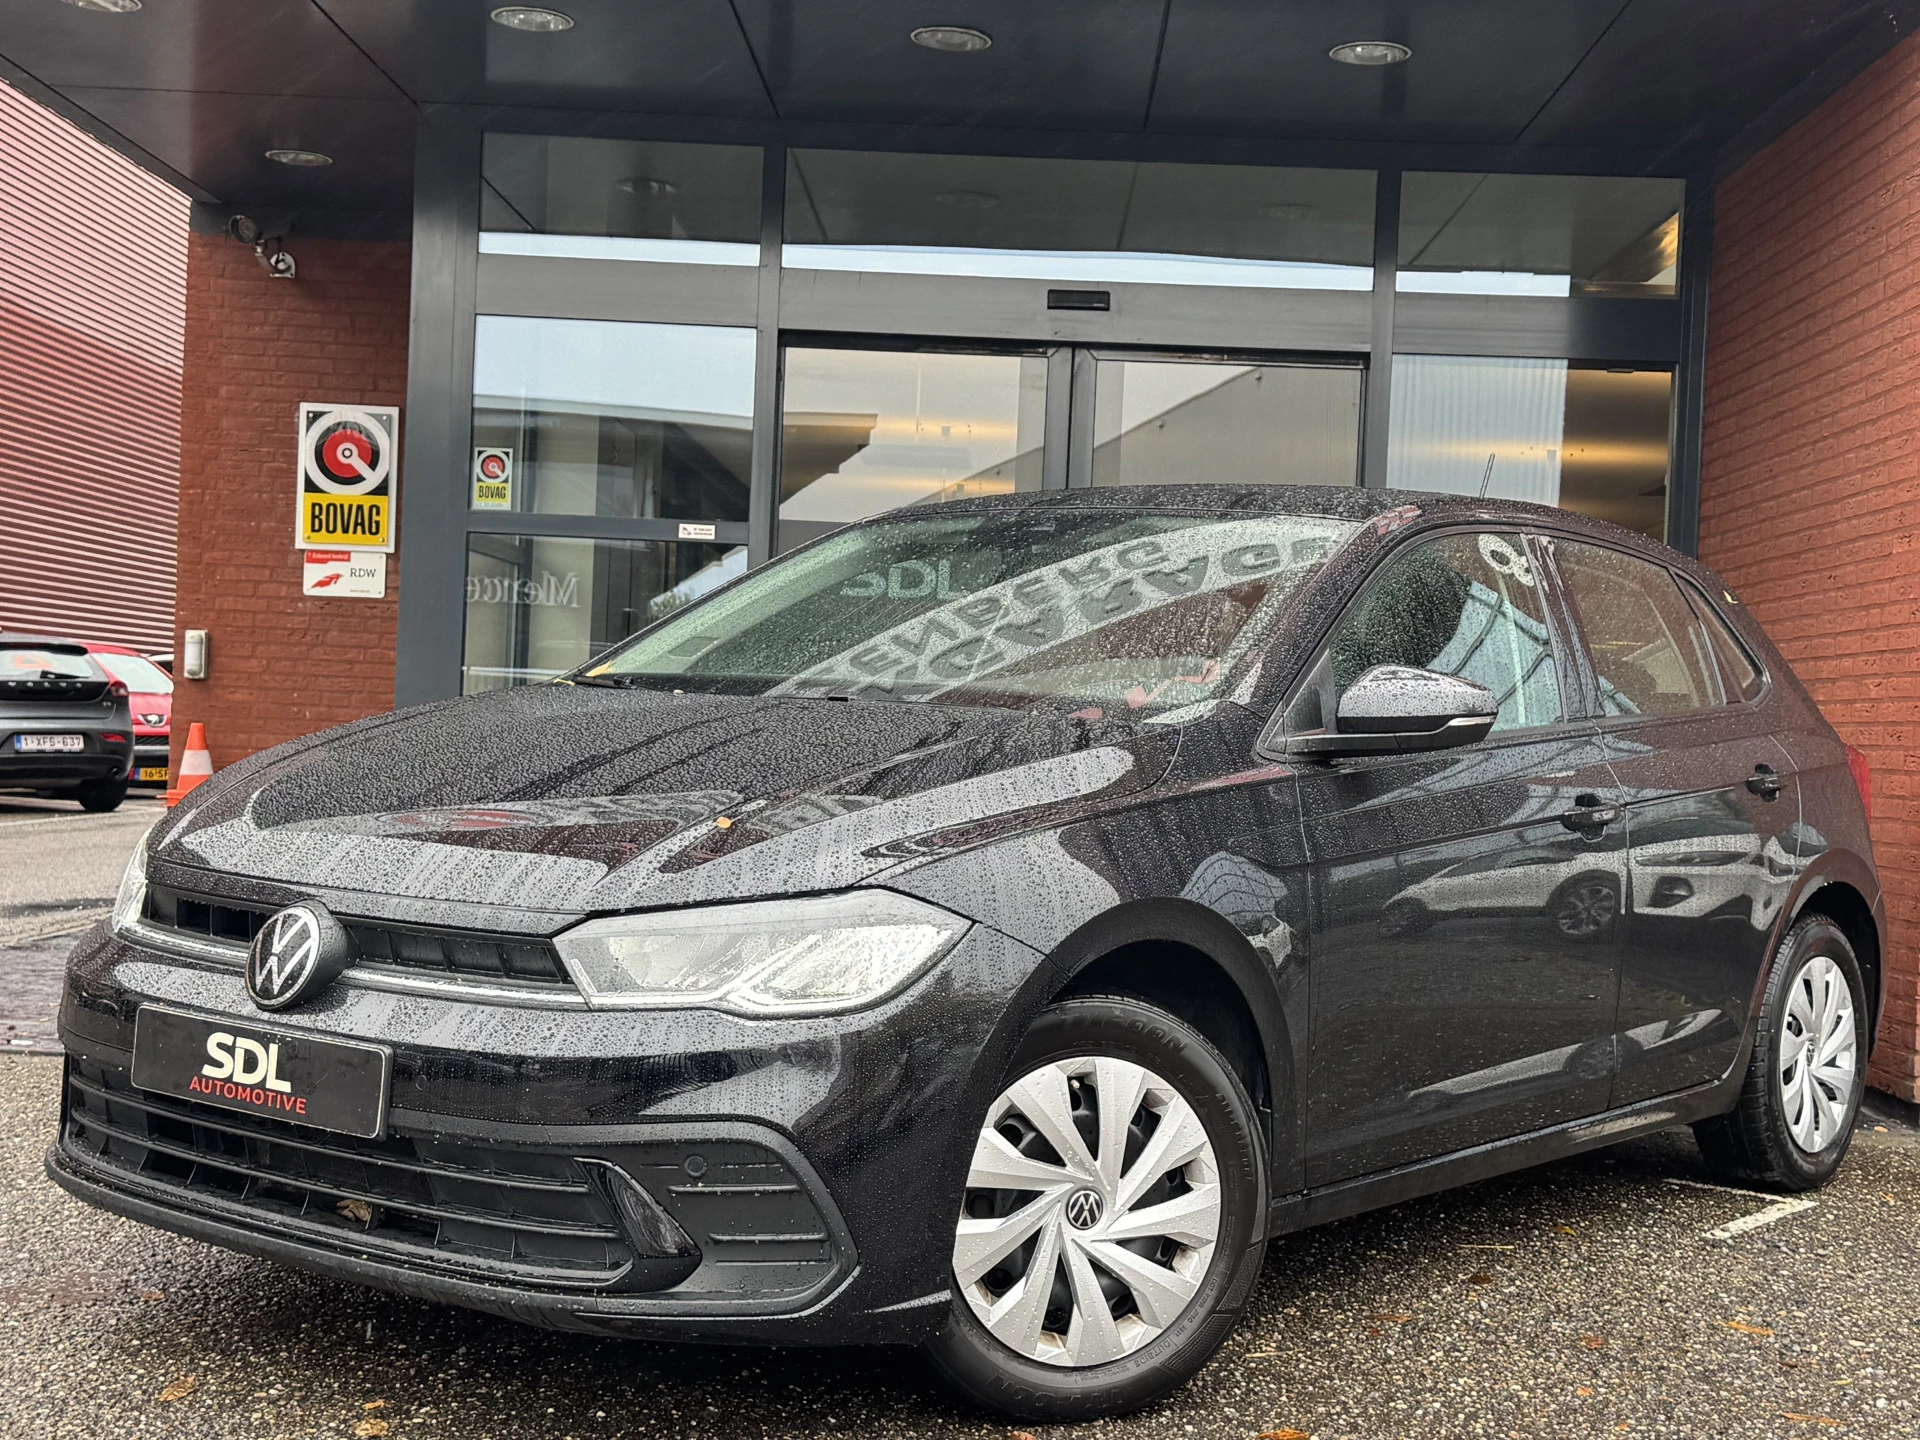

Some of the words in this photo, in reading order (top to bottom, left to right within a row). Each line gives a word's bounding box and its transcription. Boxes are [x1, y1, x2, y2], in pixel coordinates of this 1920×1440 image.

[478, 484, 506, 500] BOVAG
[311, 502, 381, 536] BOVAG
[350, 567, 376, 578] RDW
[201, 1031, 291, 1093] SDL
[189, 1076, 307, 1115] AUTOMOTIVE
